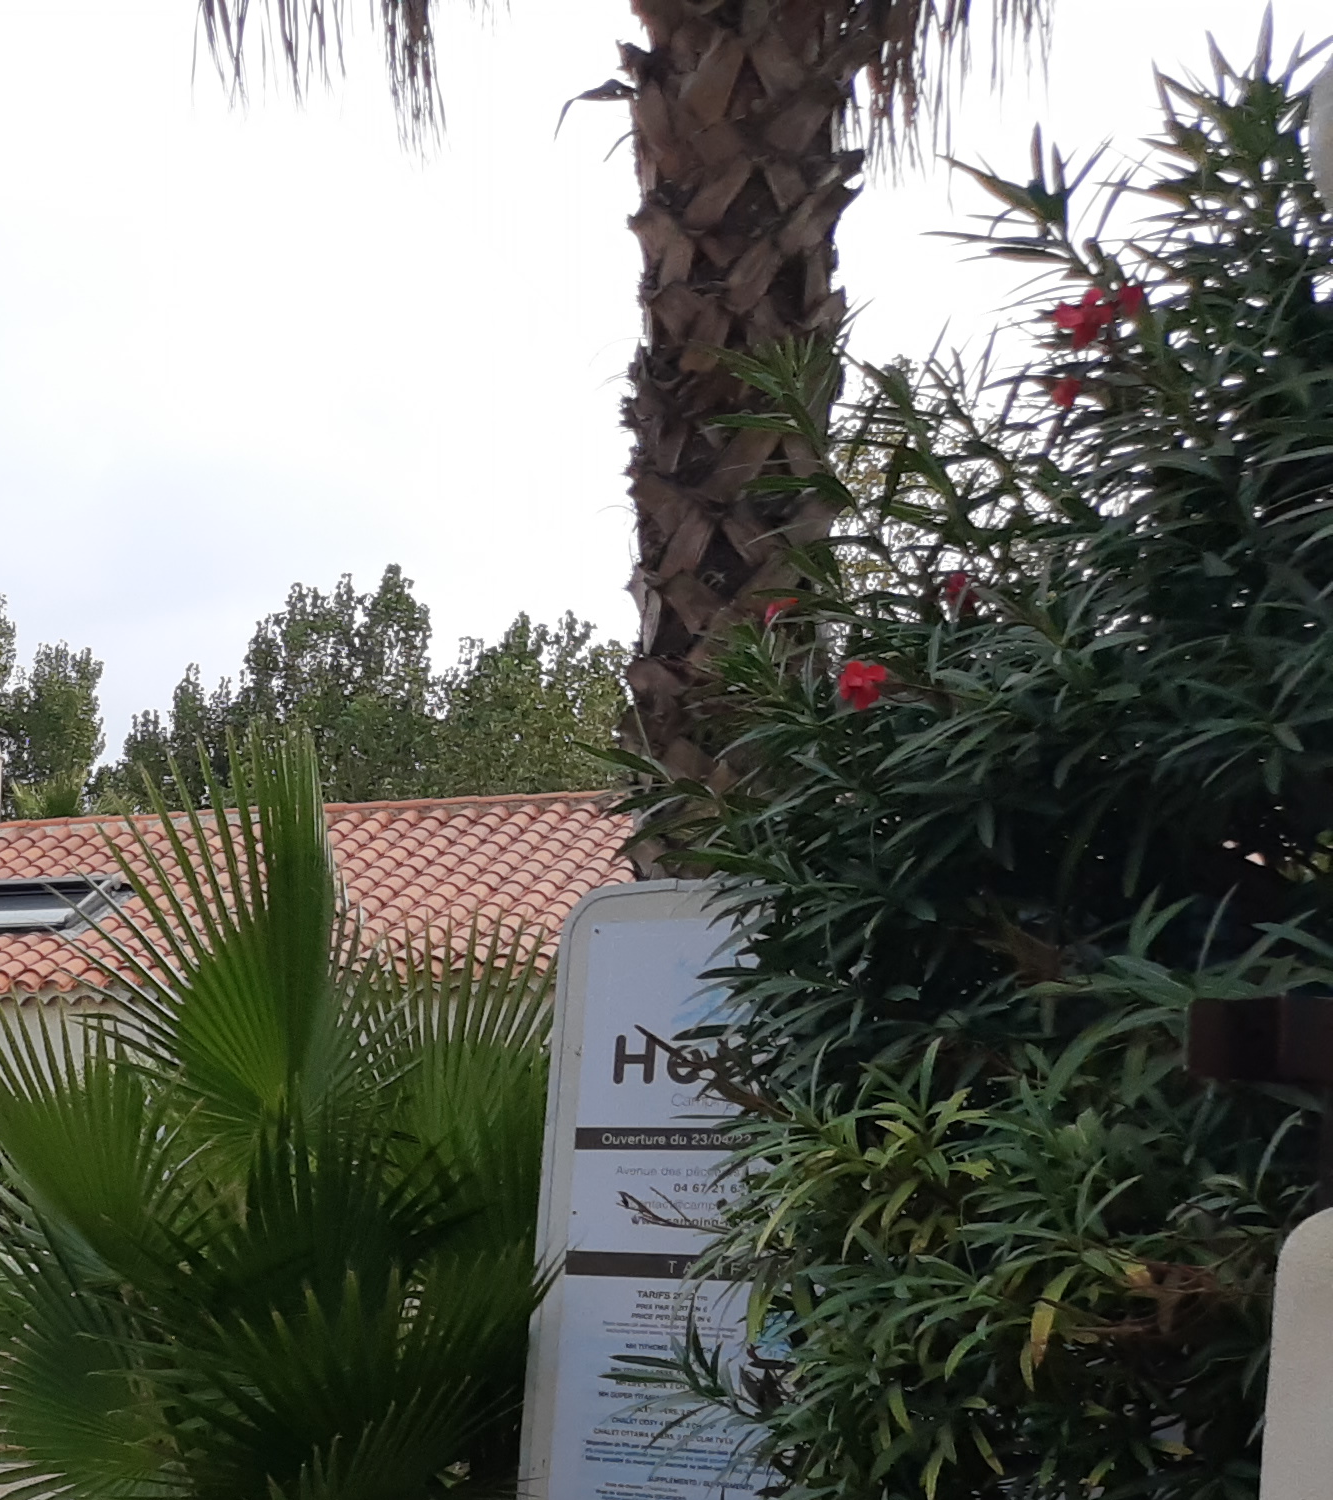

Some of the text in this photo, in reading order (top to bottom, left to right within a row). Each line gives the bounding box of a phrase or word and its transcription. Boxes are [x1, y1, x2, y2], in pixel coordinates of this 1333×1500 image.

[601, 1132, 666, 1145] Ouverture
[670, 1134, 687, 1145] du
[616, 1165, 657, 1176] Avenue
[660, 1167, 682, 1177] des
[673, 1183, 687, 1193] 04
[692, 1183, 706, 1193] 67
[637, 1290, 670, 1301] TARIFS
